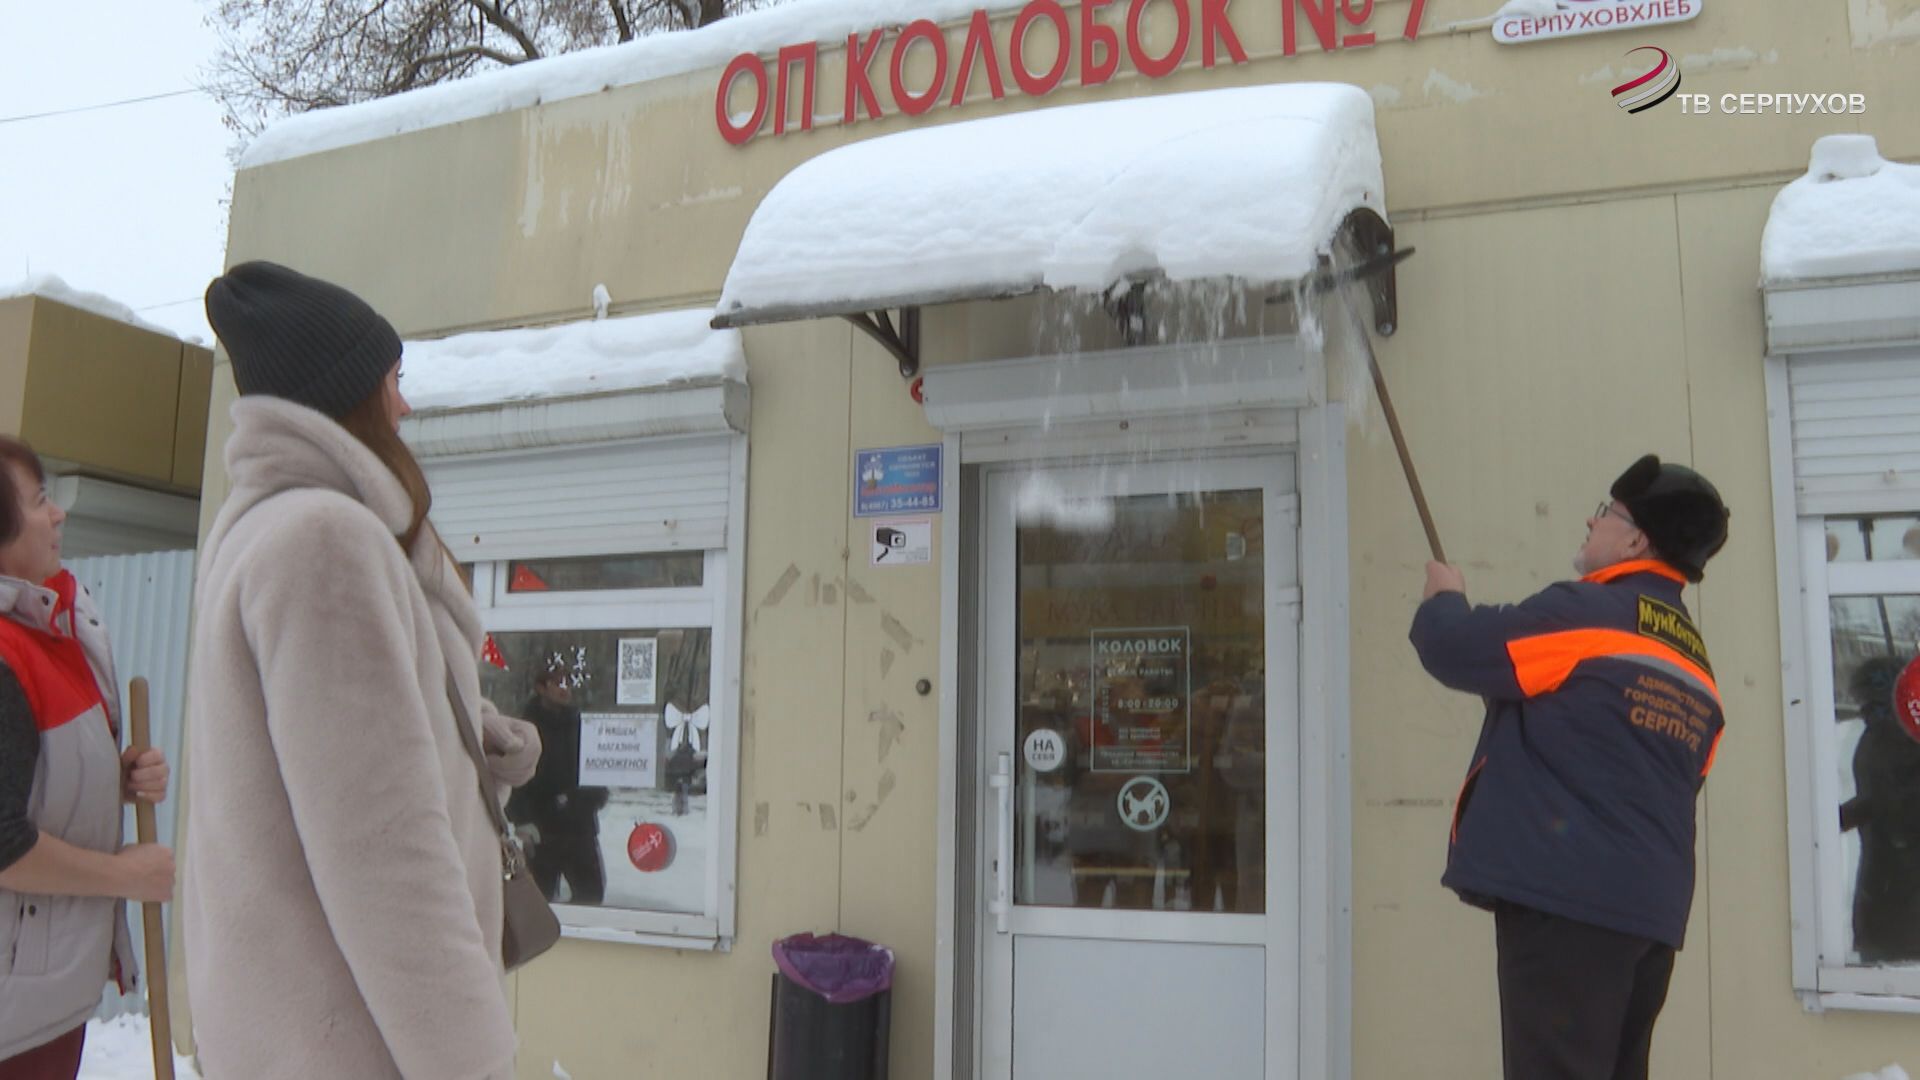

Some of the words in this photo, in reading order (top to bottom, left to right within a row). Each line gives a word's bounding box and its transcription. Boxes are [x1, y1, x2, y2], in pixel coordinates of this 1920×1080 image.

[1503, 0, 1692, 38] СЕРПУХОВХЛЕБ
[715, 52, 817, 146] ОП
[844, 0, 1249, 125] КОЛОБОК
[1033, 739, 1055, 751] НА
[585, 758, 648, 770] МОРОЖЕНОЕ
